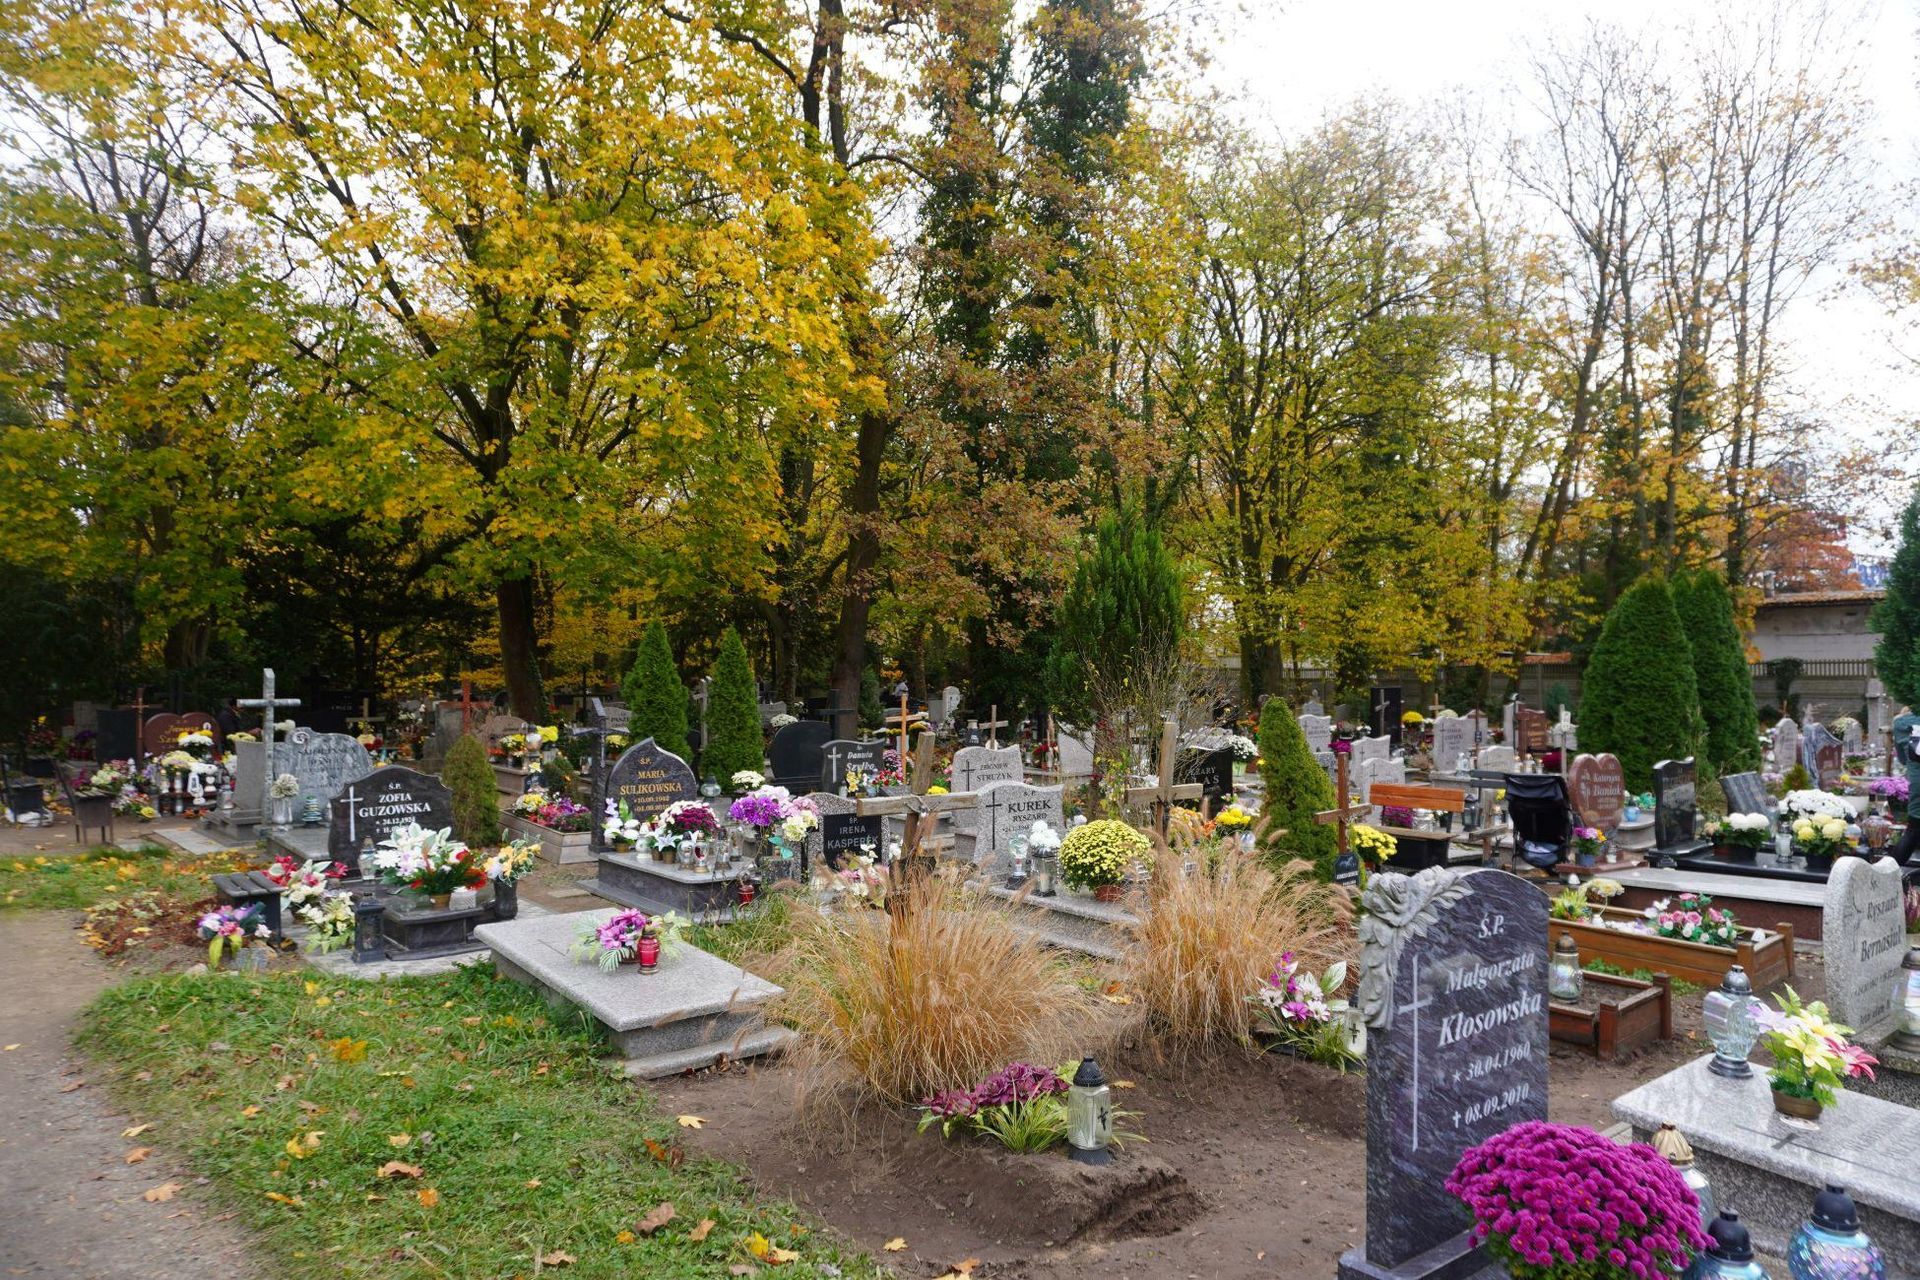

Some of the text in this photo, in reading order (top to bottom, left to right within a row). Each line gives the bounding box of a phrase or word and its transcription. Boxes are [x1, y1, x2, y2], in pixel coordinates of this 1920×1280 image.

[638, 769, 665, 779] MARIA
[619, 782, 682, 795] SULIKOWSKA
[379, 793, 412, 803] ZOFIA
[359, 802, 432, 818] GUZOWSKA
[1008, 799, 1052, 813] KUREK
[1013, 812, 1047, 822] RYSZARD
[839, 825, 866, 835] IRENA
[1479, 912, 1504, 938] Ś.P.
